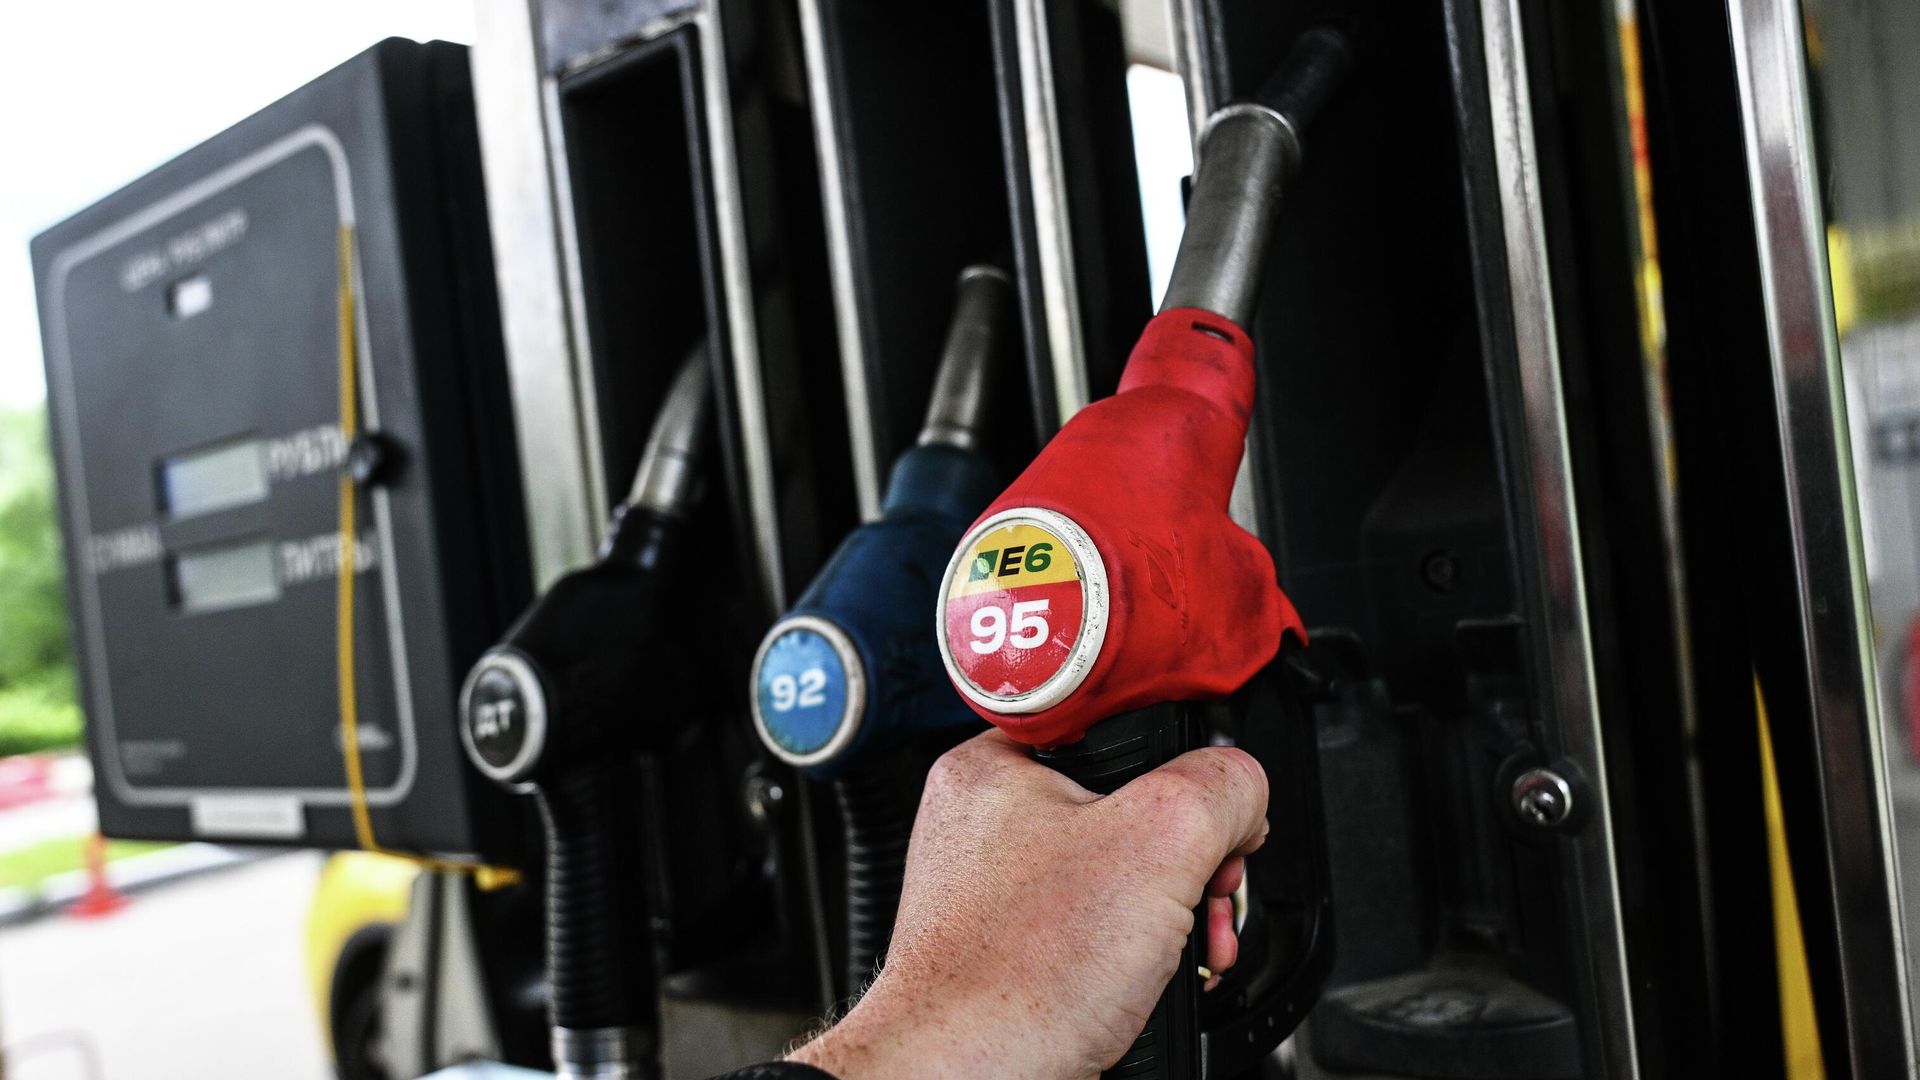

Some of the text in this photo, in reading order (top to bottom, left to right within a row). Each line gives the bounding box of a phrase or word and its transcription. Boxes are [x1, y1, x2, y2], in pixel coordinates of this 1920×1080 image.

[997, 542, 1054, 577] E6
[969, 598, 1051, 656] 95
[771, 667, 827, 711] 92
